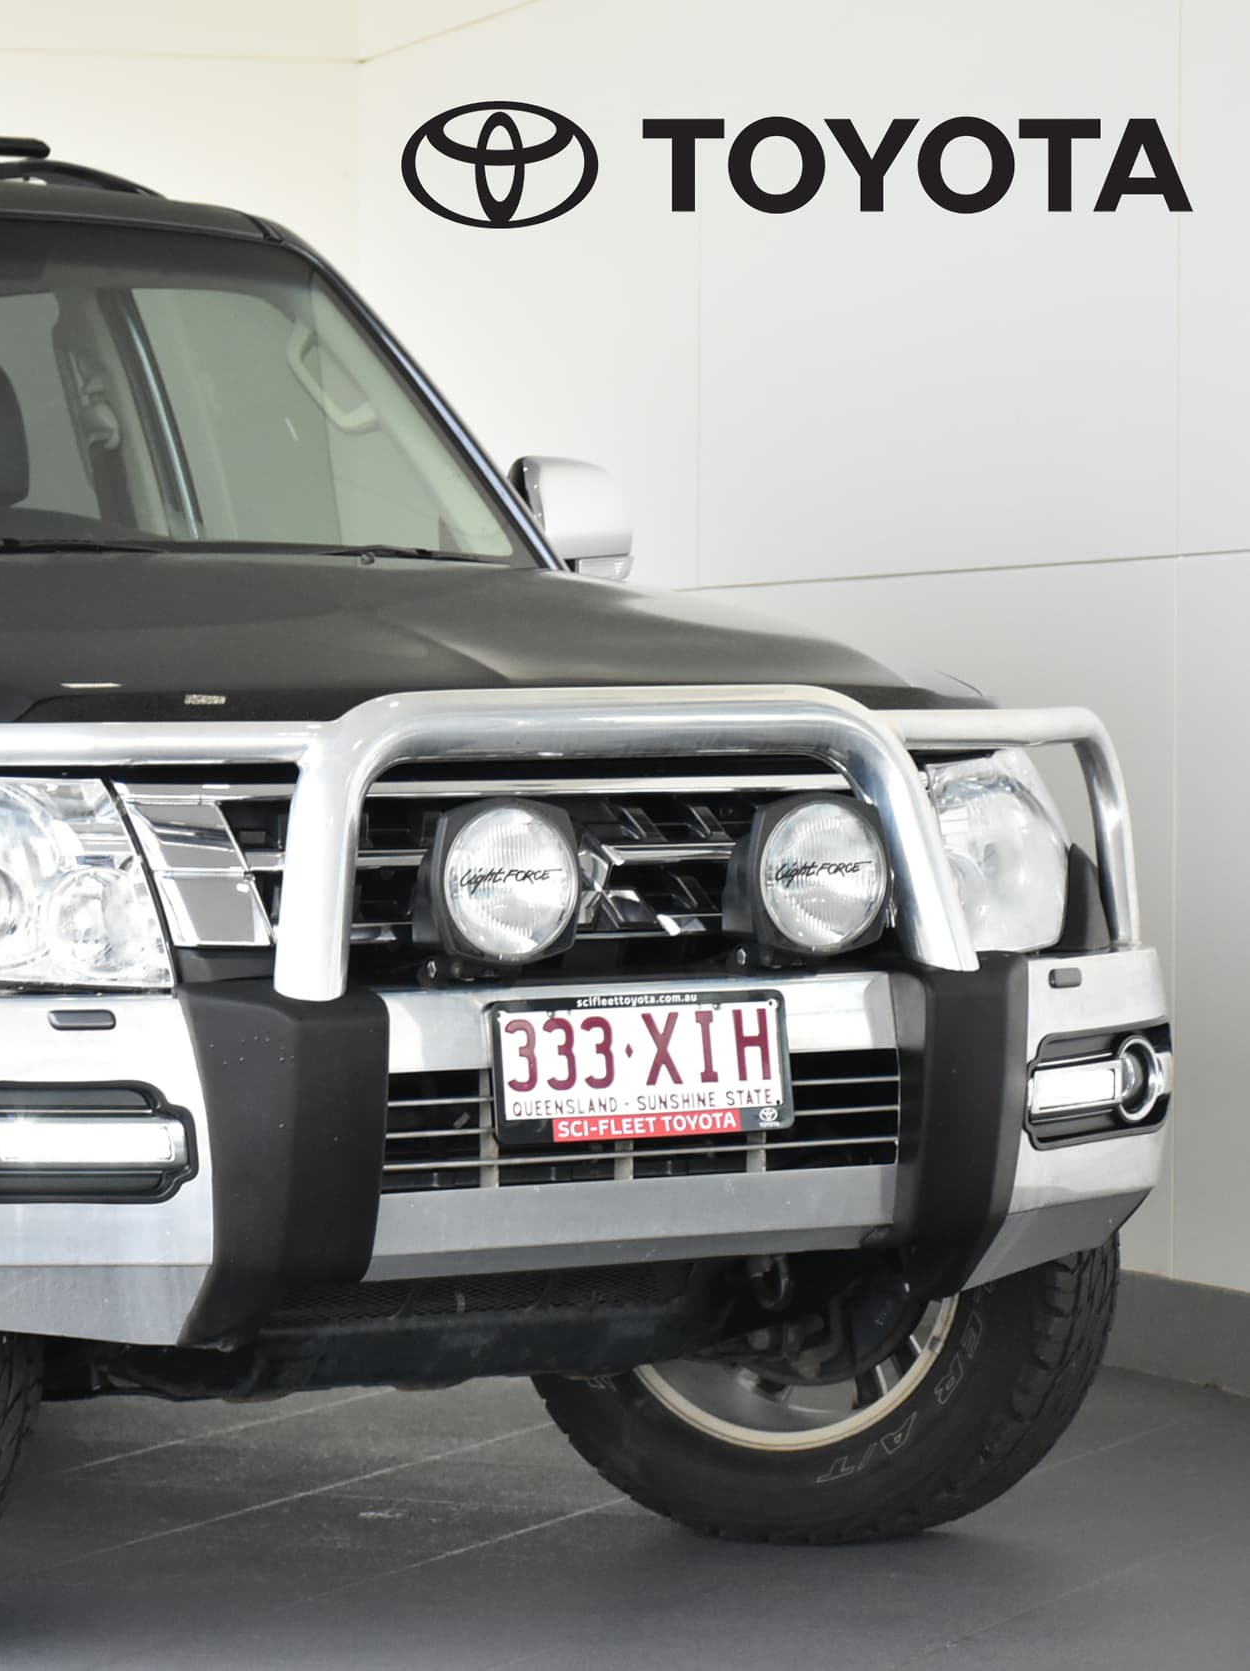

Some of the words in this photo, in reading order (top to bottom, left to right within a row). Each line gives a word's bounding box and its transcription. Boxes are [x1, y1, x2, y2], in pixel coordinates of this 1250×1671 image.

[576, 993, 698, 1007] scifleettoyota.com.au
[512, 1096, 618, 1117] QUEENSLAND
[637, 1091, 717, 1111] SUNSHINE
[725, 1088, 773, 1106] STATE
[557, 1117, 657, 1138] SCI-FLEET
[659, 1111, 738, 1132] TOYOTA
